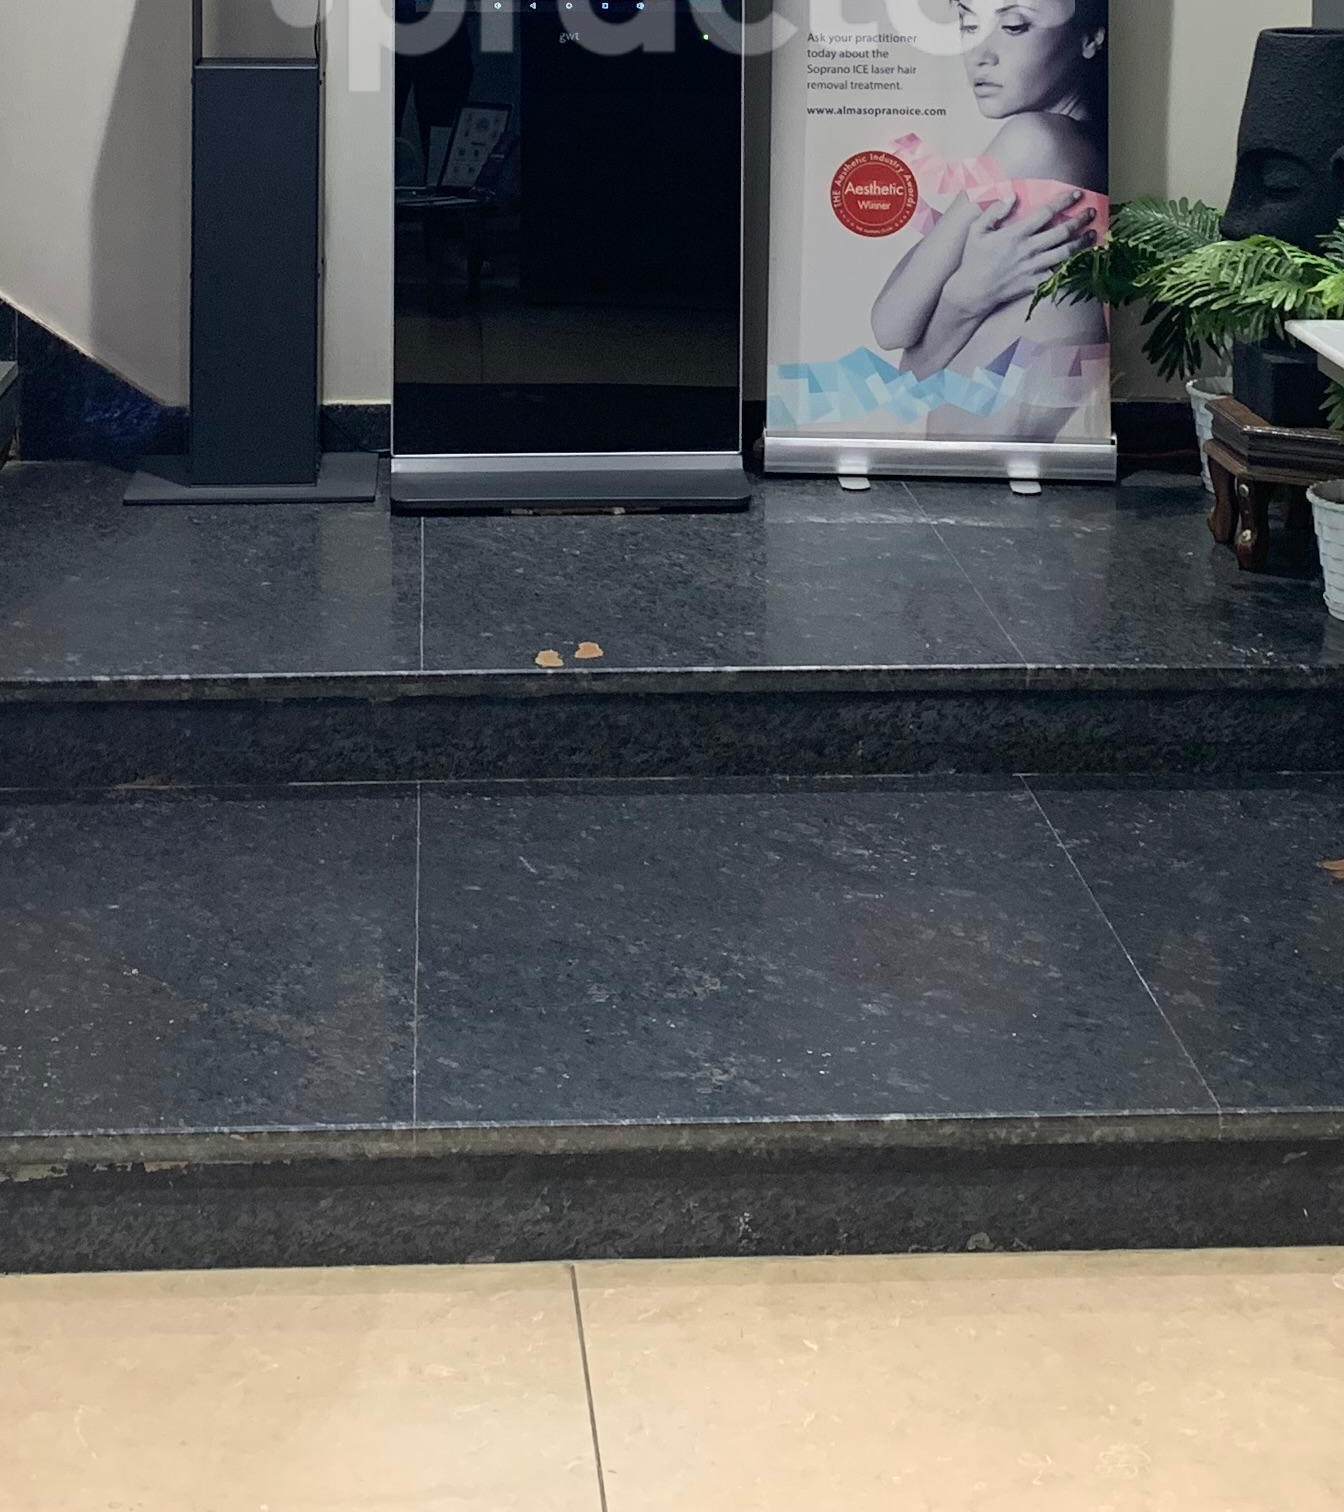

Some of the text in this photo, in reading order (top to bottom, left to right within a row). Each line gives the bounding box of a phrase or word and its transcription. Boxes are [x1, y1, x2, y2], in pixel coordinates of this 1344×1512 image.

[807, 32, 917, 44] Ask your practitioner
[807, 49, 889, 60] today about the
[807, 64, 918, 75] Soprano ICE laser hair
[807, 80, 848, 90] removal
[807, 106, 947, 117] www.almasopranoice.com
[844, 180, 904, 196] Aesthetic
[857, 199, 892, 210] Winner
